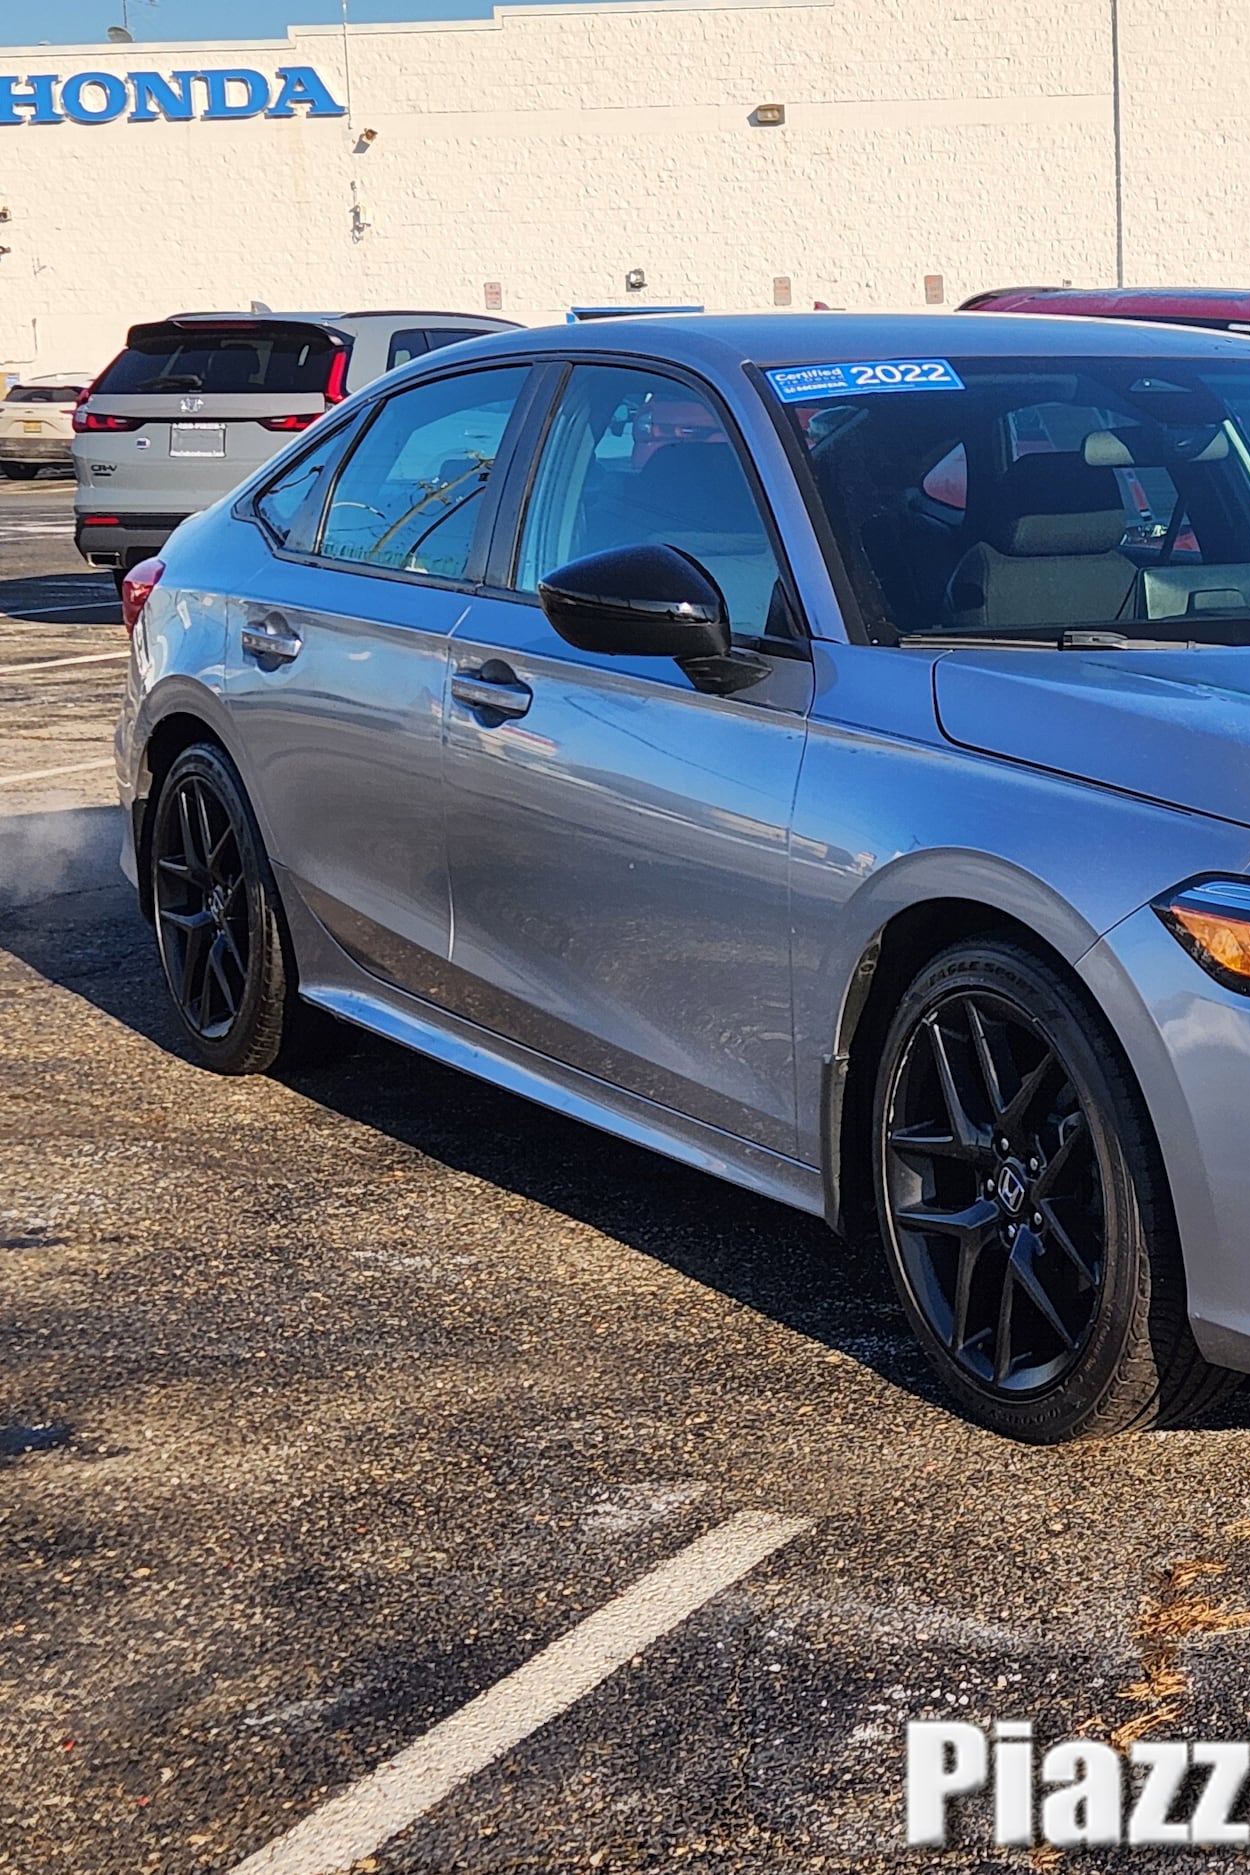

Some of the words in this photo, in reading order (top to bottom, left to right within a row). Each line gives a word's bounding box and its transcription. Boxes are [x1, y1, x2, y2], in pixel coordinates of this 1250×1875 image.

[0, 66, 346, 123] HONDA
[775, 367, 842, 382] Certified
[850, 364, 951, 385] 2022
[796, 381, 848, 392] HONDA
